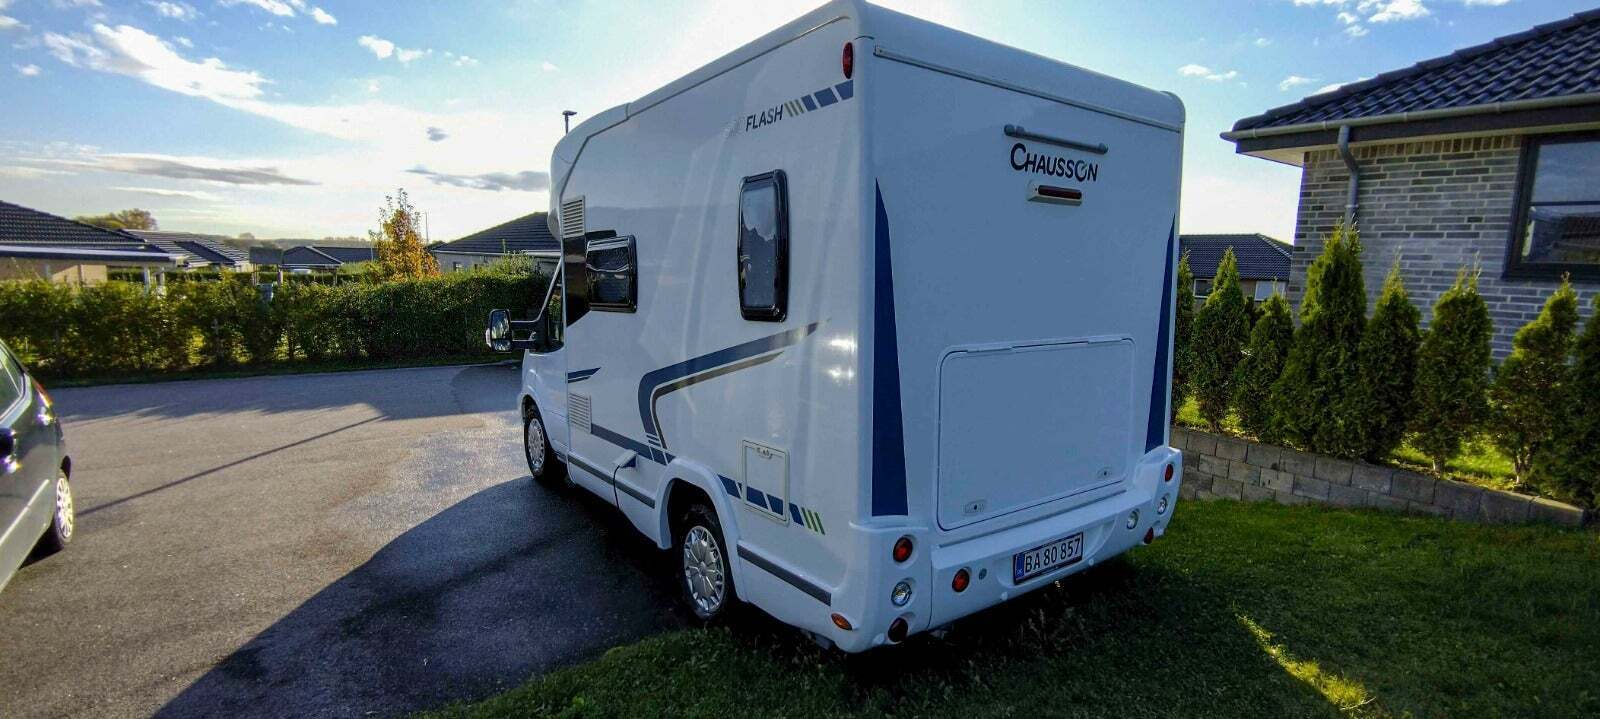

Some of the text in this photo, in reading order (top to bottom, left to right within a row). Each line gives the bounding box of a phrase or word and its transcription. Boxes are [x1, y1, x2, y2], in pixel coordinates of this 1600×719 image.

[745, 103, 784, 132] FLASH
[1010, 142, 1099, 182] CHAUSSON
[1025, 552, 1041, 573] BA
[1043, 546, 1058, 566] 80
[1060, 538, 1081, 560] 857
